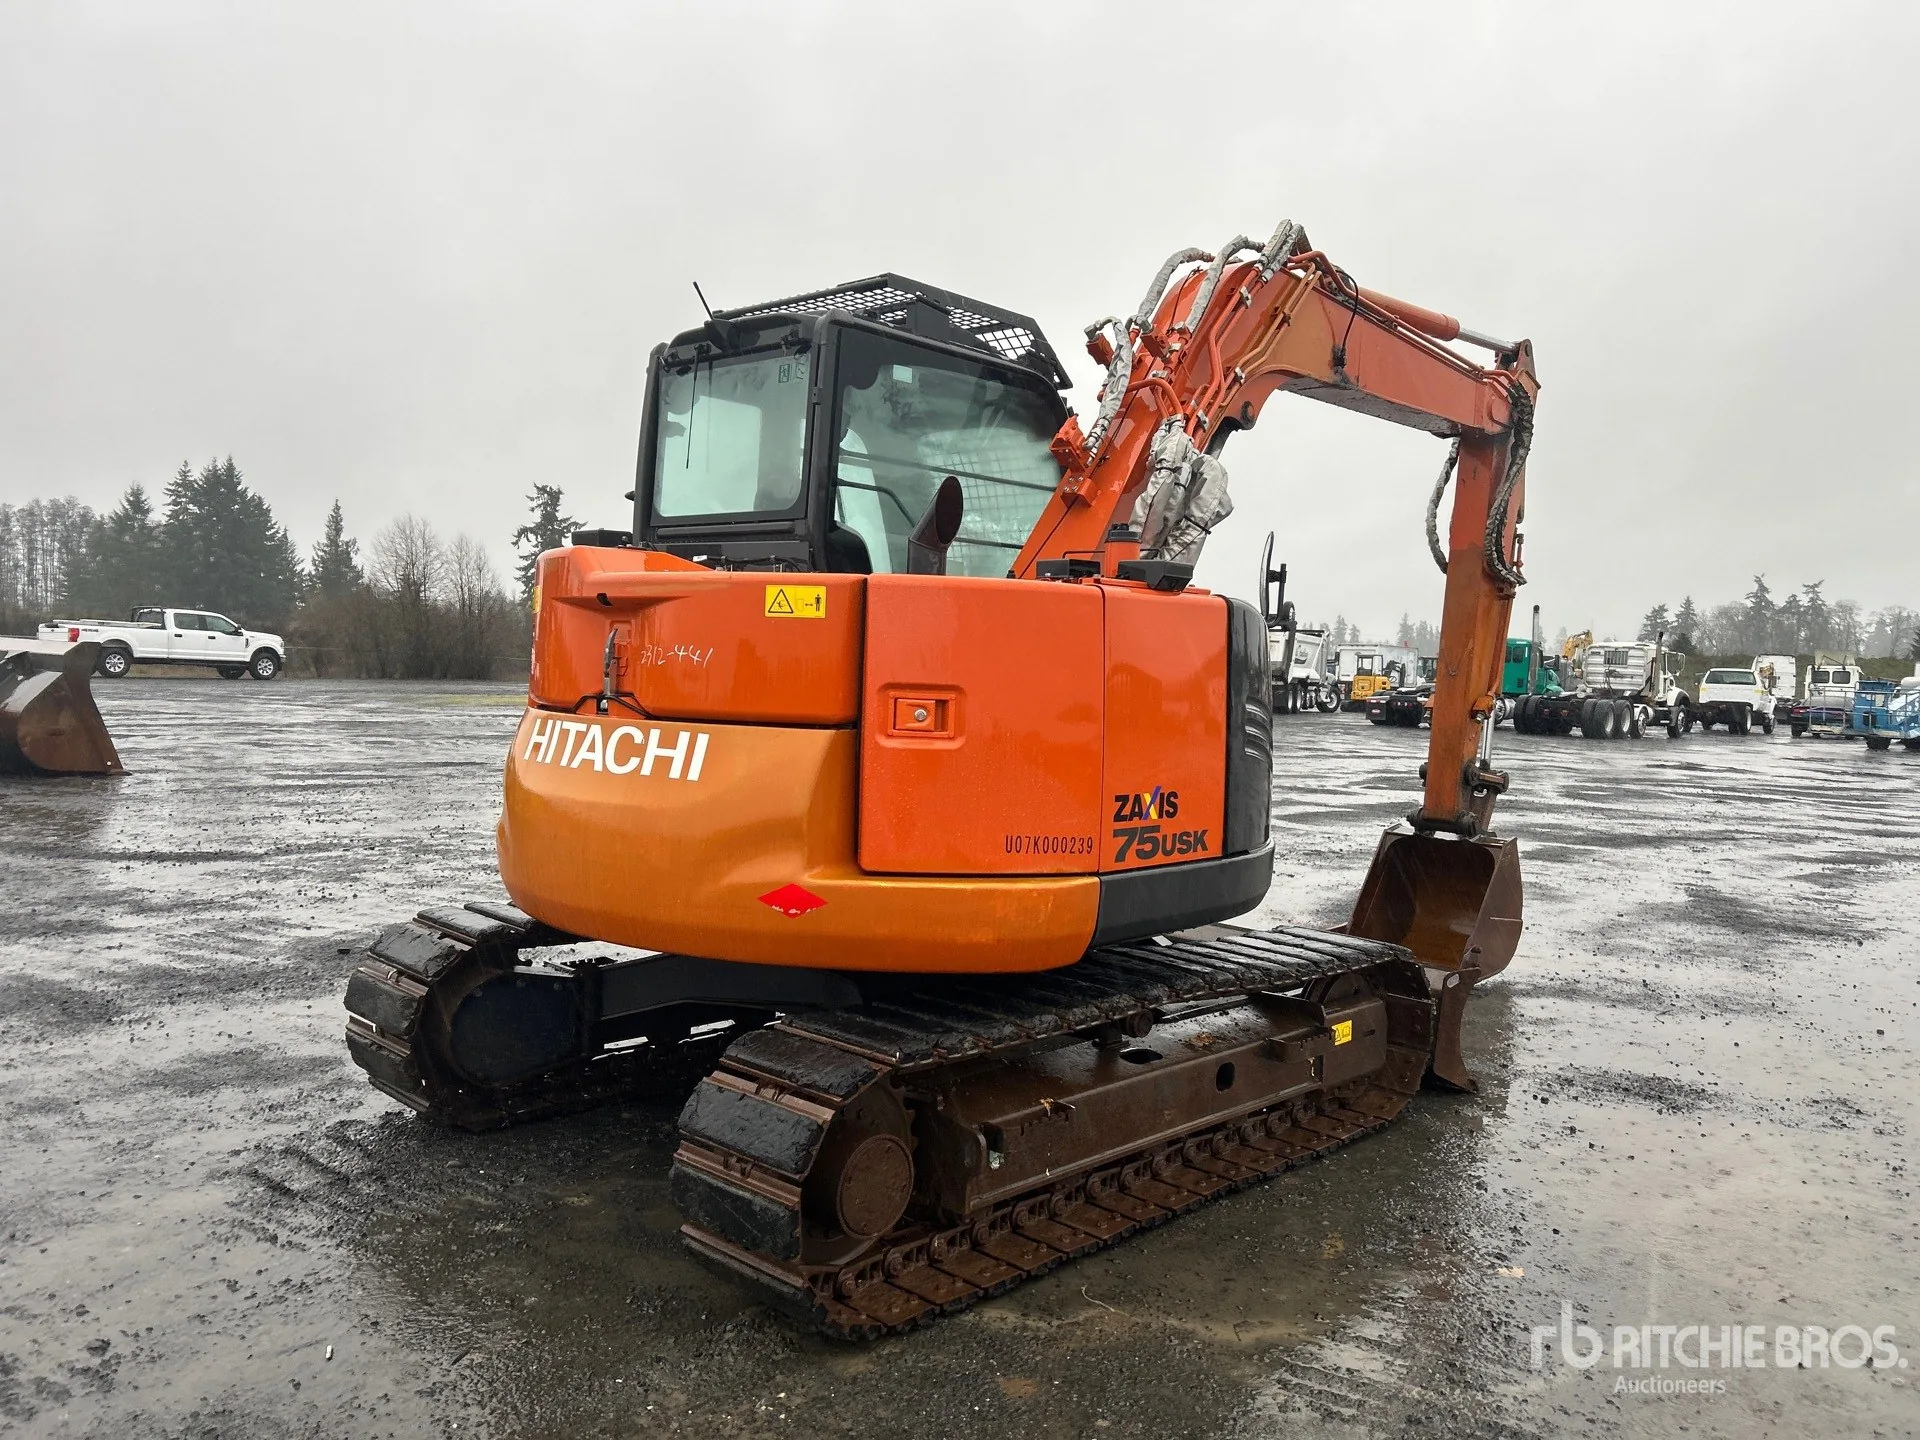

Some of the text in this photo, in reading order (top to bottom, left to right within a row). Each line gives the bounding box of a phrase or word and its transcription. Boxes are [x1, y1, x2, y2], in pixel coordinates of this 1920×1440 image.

[640, 644, 714, 669] 2312-441
[523, 717, 710, 782] HITACHI
[1113, 785, 1179, 823] ZAXIS
